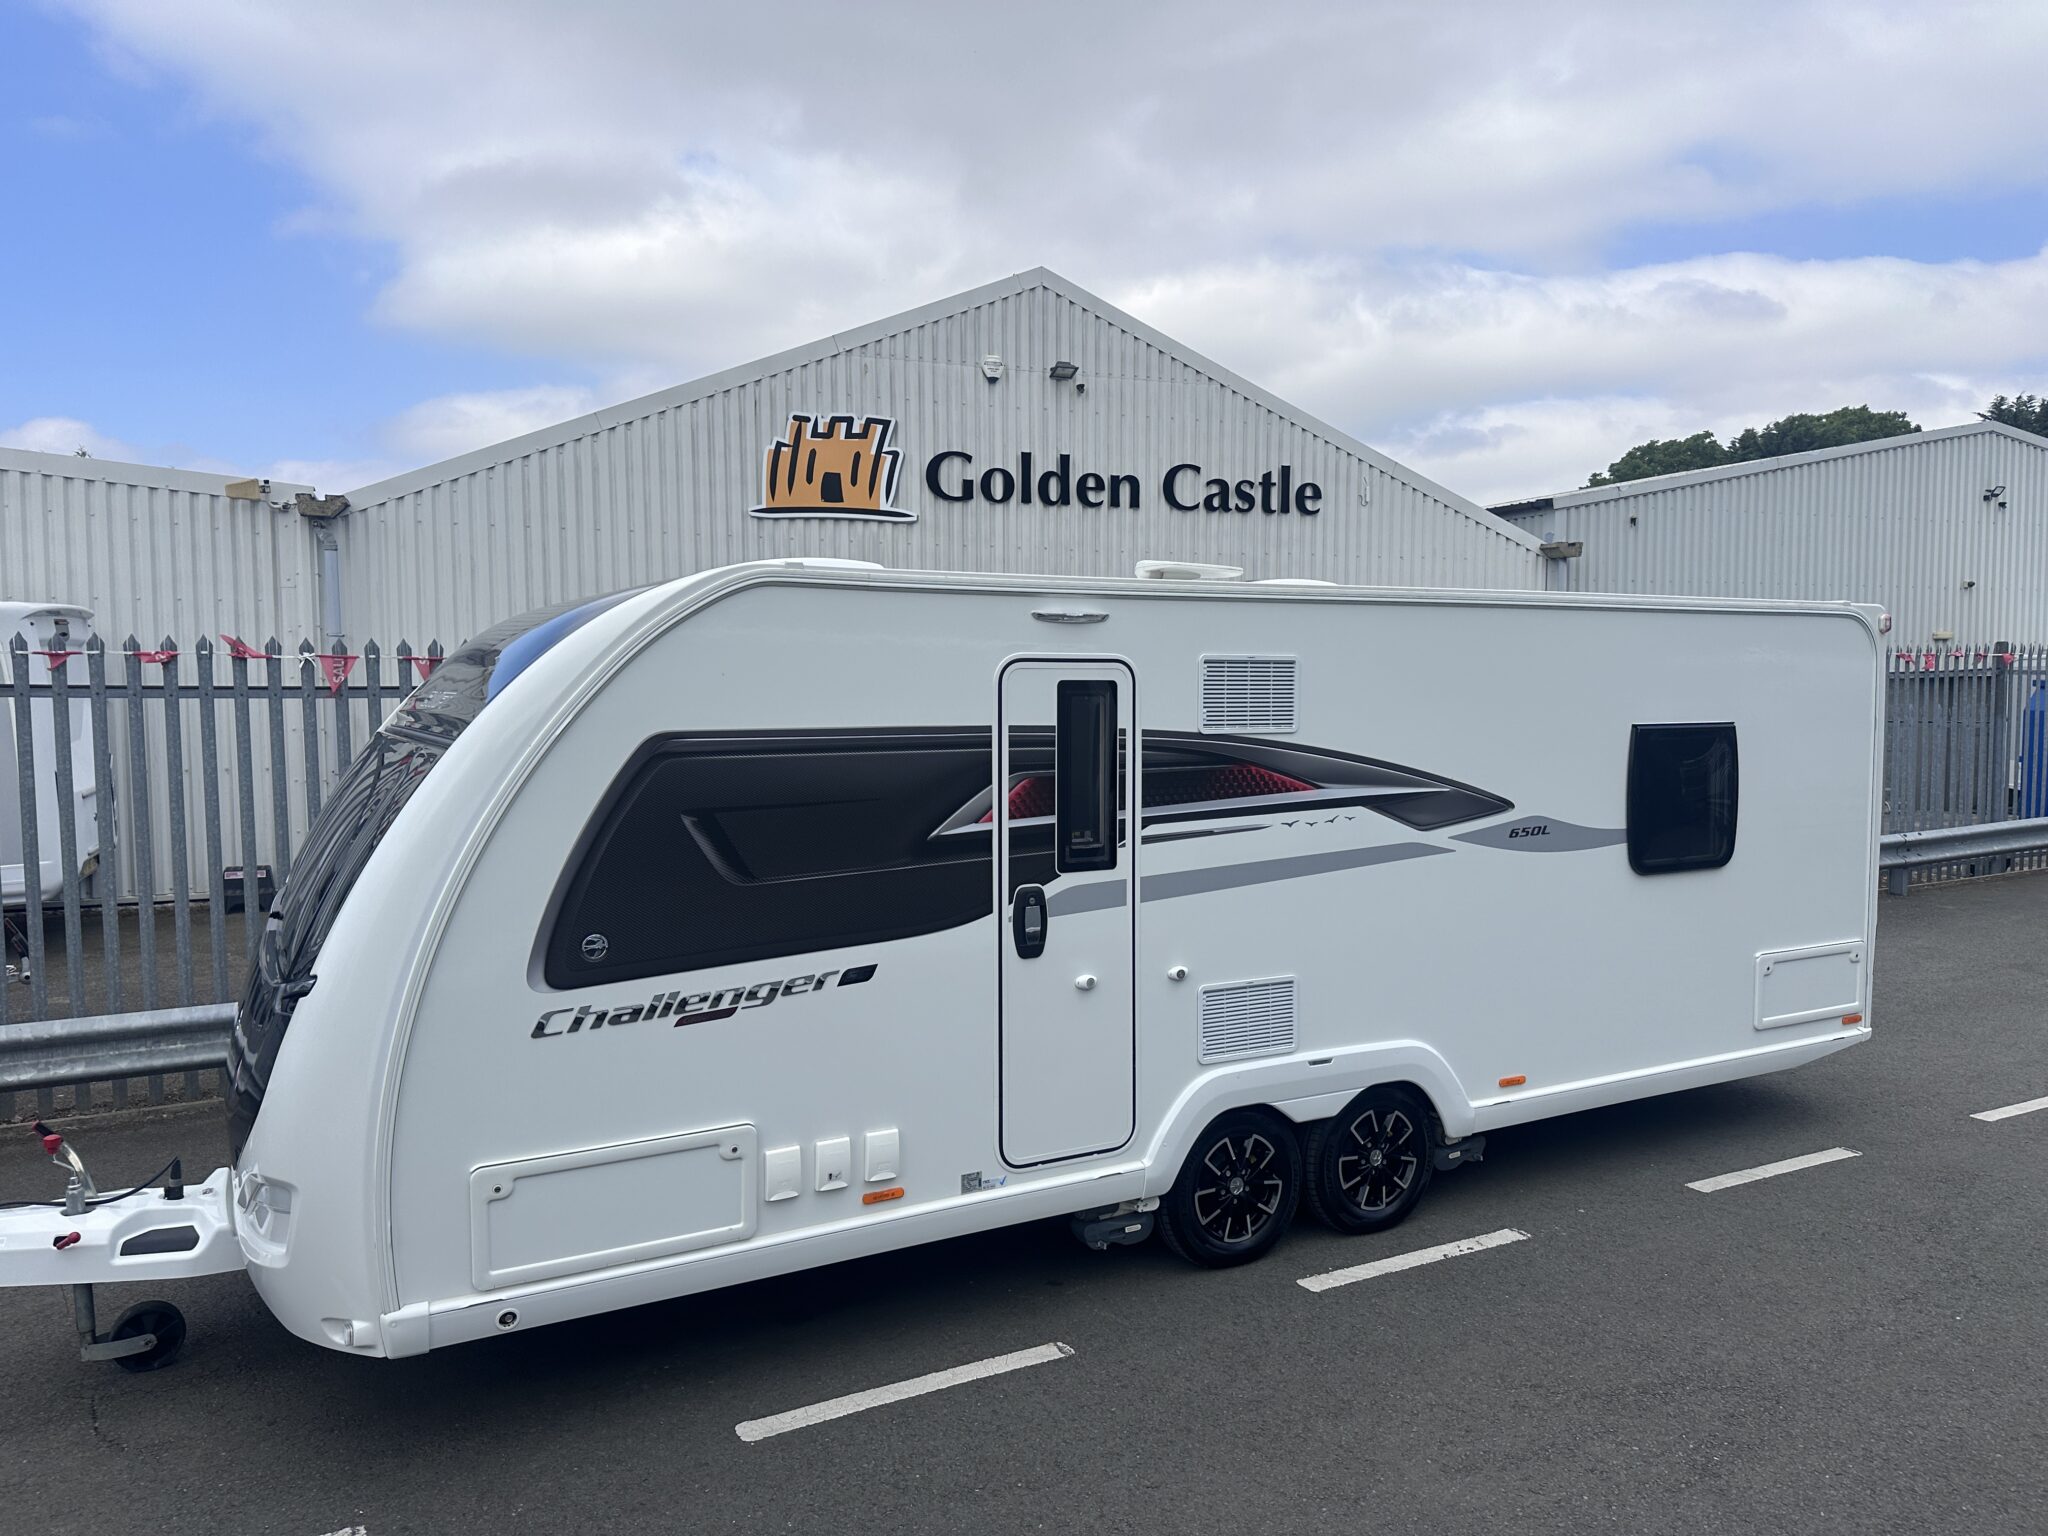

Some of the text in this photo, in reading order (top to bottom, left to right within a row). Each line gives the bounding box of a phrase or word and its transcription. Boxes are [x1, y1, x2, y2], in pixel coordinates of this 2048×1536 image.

[925, 451, 1322, 515] Golden Castle
[1508, 825, 1550, 839] 650L
[530, 970, 840, 1039] Challenger
